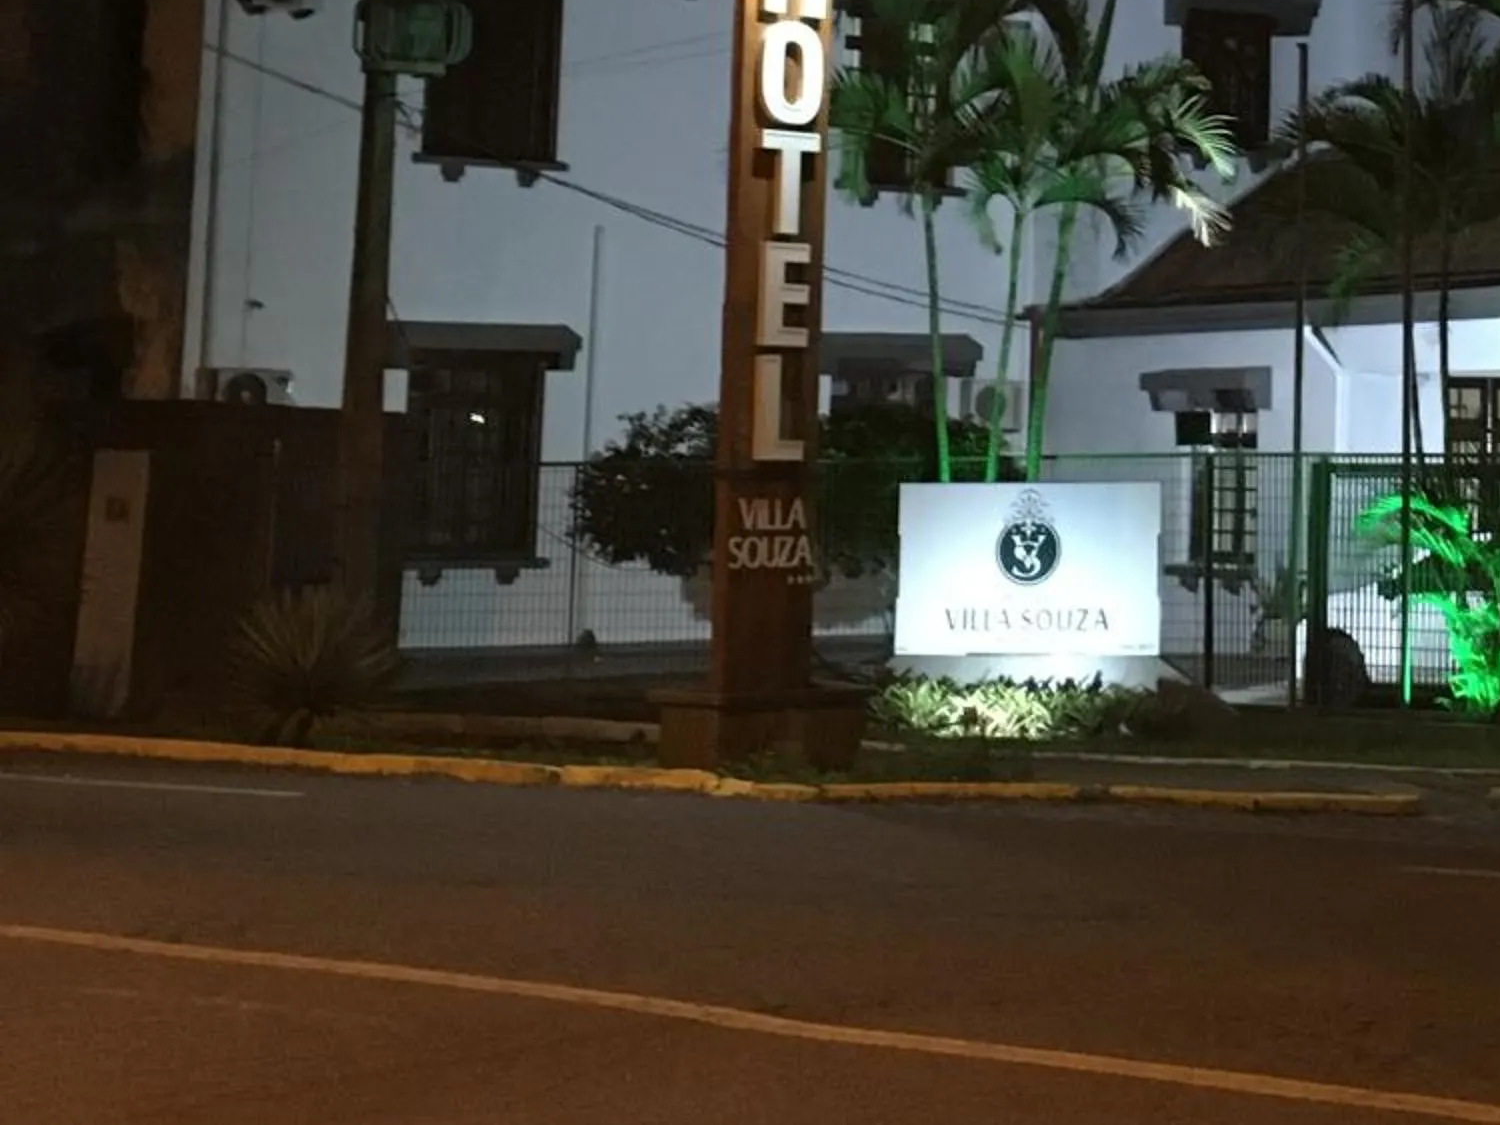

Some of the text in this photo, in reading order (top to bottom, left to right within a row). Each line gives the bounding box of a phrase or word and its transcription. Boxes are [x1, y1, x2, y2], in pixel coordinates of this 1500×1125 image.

[738, 496, 807, 530] VILLA
[728, 534, 814, 569] SOUZA
[944, 607, 1110, 632] VILLA SOUZA
